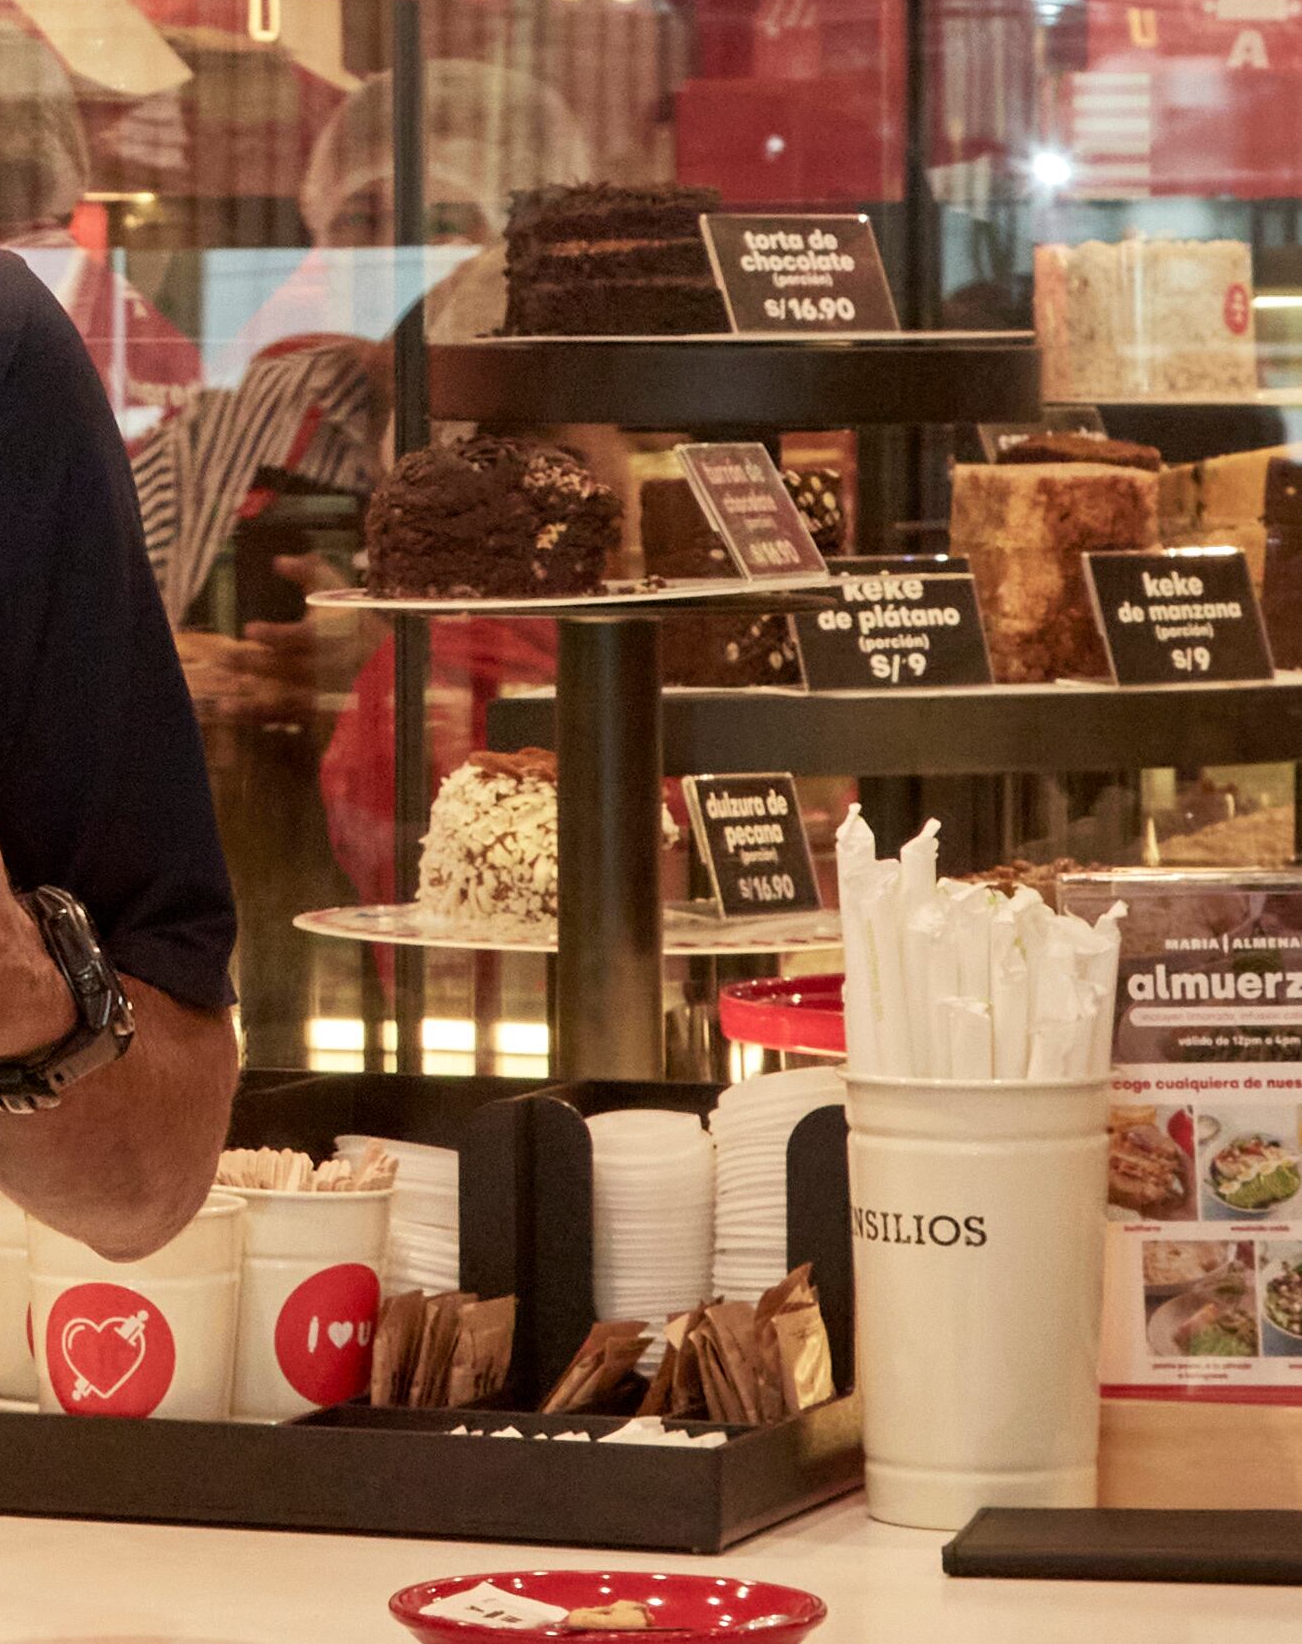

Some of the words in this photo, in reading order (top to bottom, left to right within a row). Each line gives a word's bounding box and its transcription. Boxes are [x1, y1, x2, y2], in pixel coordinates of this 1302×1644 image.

[743, 230, 805, 251] torta
[808, 228, 838, 250] de
[740, 250, 855, 272] chocolate
[1142, 571, 1204, 598] keke
[817, 610, 852, 630] de
[858, 604, 961, 635] plátano
[1118, 601, 1145, 623] de
[1149, 602, 1243, 621] manzana
[706, 791, 766, 820] dulzura
[766, 788, 789, 816] de
[724, 823, 784, 853] pecana
[1164, 938, 1220, 950] MARIA
[1127, 963, 1302, 1000] almuerz
[1215, 1035, 1230, 1046] de
[1155, 1076, 1239, 1093] cualquiera
[1243, 1076, 1263, 1089] de
